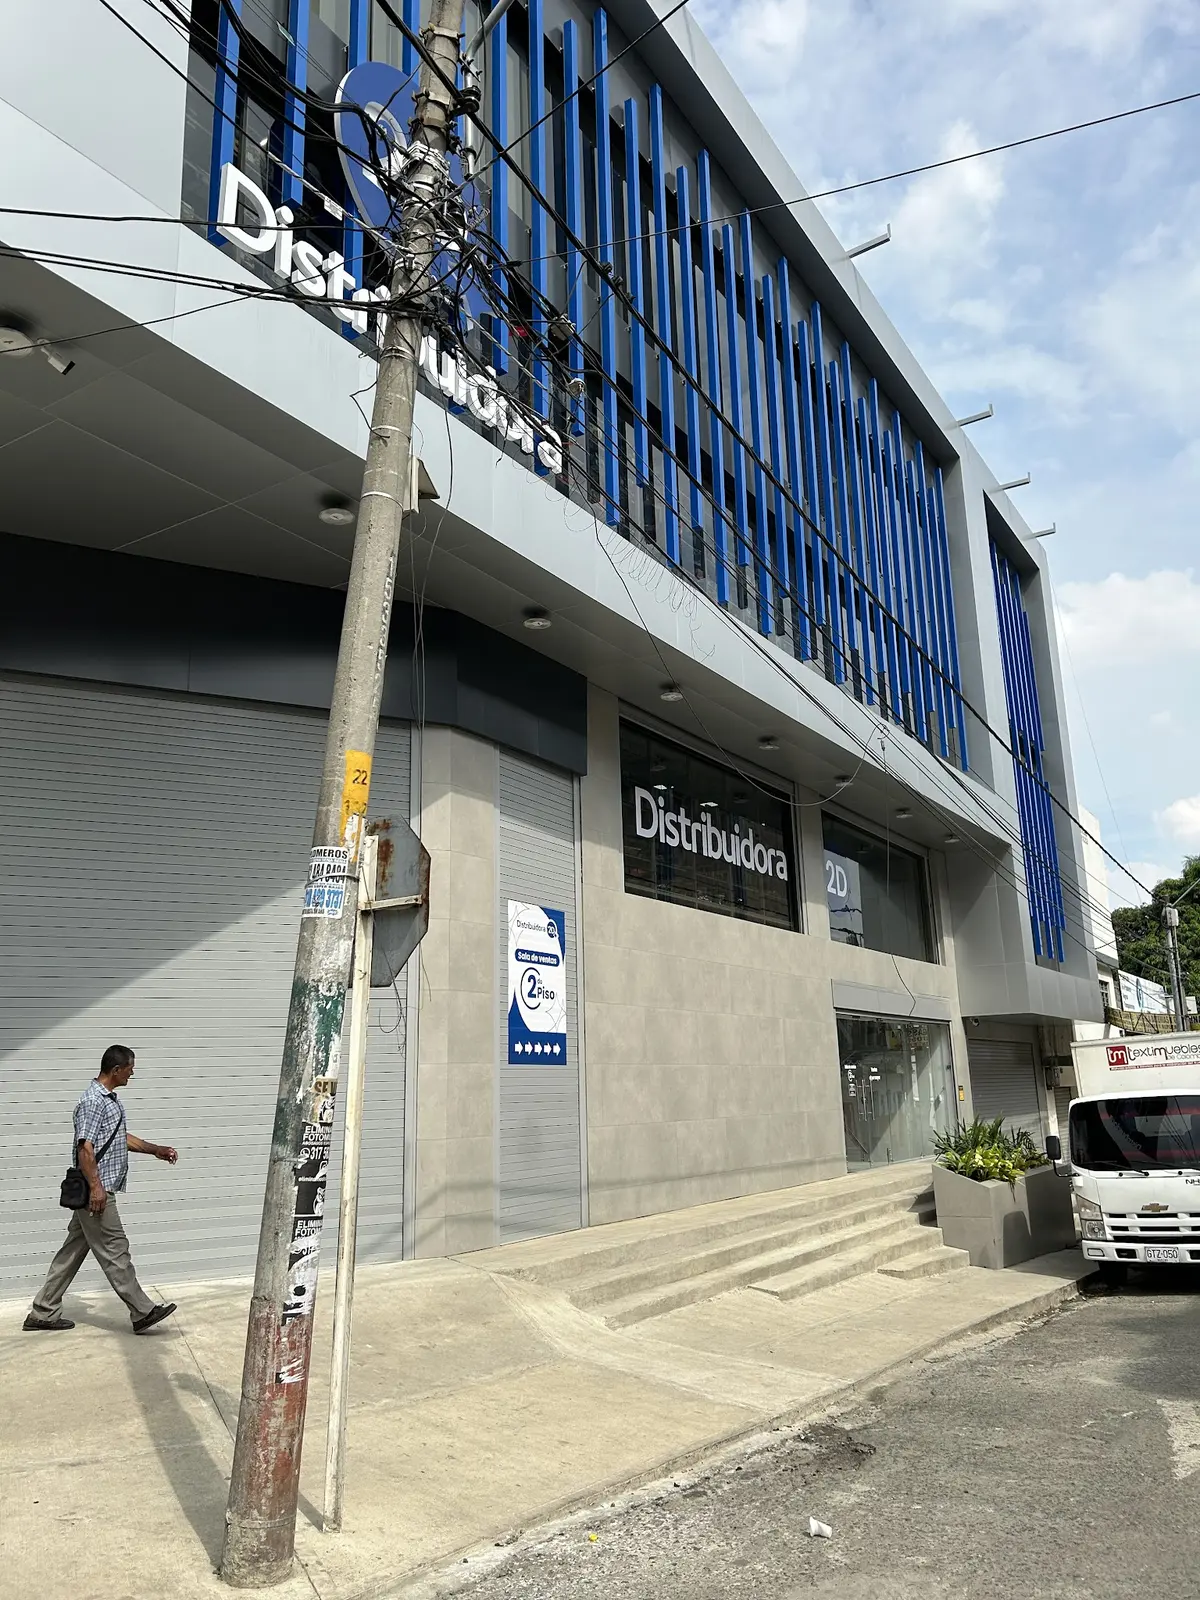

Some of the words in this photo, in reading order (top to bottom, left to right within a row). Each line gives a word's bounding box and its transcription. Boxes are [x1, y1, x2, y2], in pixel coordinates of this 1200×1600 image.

[216, 162, 563, 475] Distriuidora
[352, 769, 367, 785] 22
[634, 785, 789, 882] Distribuidora
[825, 859, 848, 898] 2D
[517, 920, 546, 932] Distribuidora
[518, 952, 530, 961] Sala
[531, 954, 538, 962] de
[539, 956, 557, 965] ventas
[528, 974, 536, 998] 2
[537, 985, 555, 1000] Piso
[310, 1146, 323, 1160] 317
